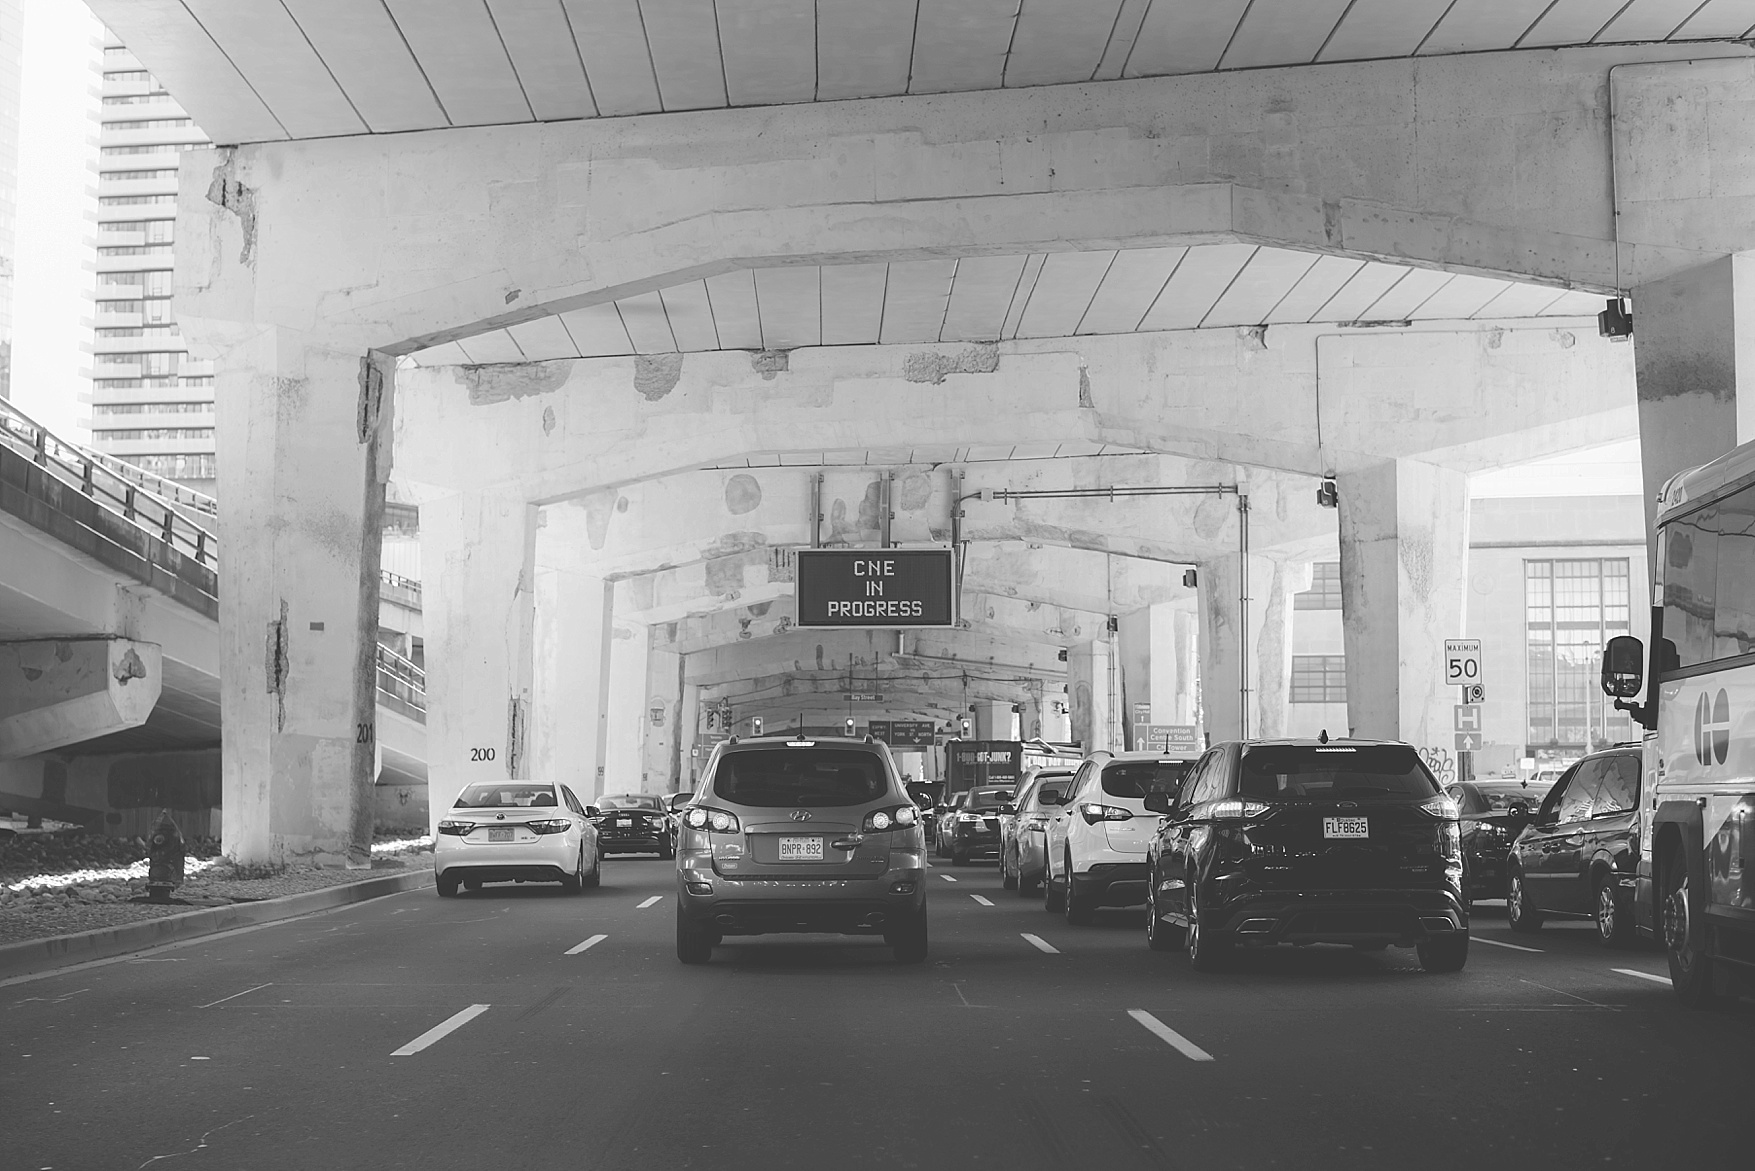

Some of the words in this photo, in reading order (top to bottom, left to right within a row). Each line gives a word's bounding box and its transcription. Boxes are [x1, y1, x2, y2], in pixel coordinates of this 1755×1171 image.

[854, 560, 895, 576] CNE
[866, 580, 883, 596] IN
[828, 601, 922, 617] PROGRESS
[1447, 644, 1479, 652] MAXIMUM
[1449, 658, 1478, 678] 50
[1457, 708, 1478, 729] H
[357, 723, 374, 744] 201
[470, 748, 496, 762] 200
[1325, 821, 1367, 834] FLF8625
